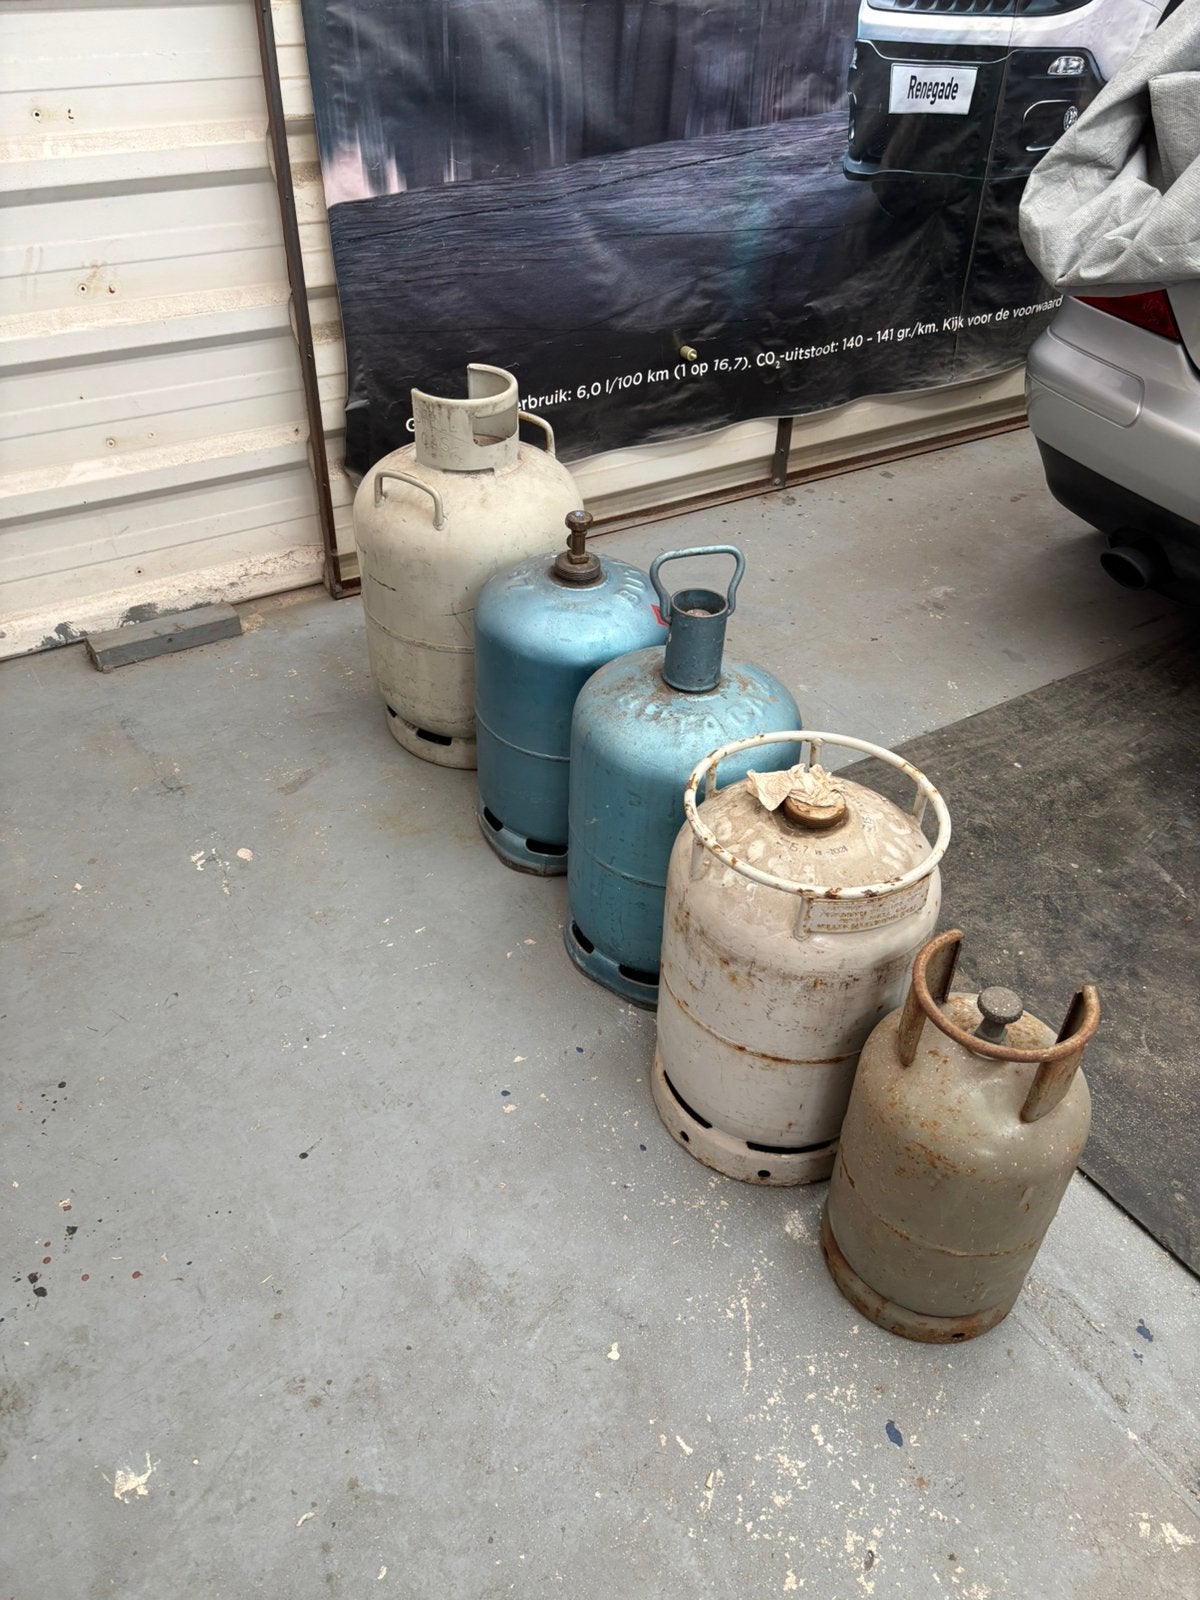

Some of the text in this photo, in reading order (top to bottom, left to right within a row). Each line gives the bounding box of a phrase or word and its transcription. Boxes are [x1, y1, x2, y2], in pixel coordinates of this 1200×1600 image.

[907, 75, 959, 104] Renegade
[577, 382, 601, 399] 6,0
[605, 370, 642, 395] l/100
[647, 369, 669, 383] km
[674, 363, 686, 381] (1
[692, 359, 709, 376] op
[713, 355, 752, 373] 16,7).
[843, 336, 863, 352] 140
[877, 330, 894, 344] 141
[898, 323, 939, 342] gr./km.
[944, 316, 964, 332] Kijk
[968, 312, 992, 327] voor
[995, 306, 1010, 320] de
